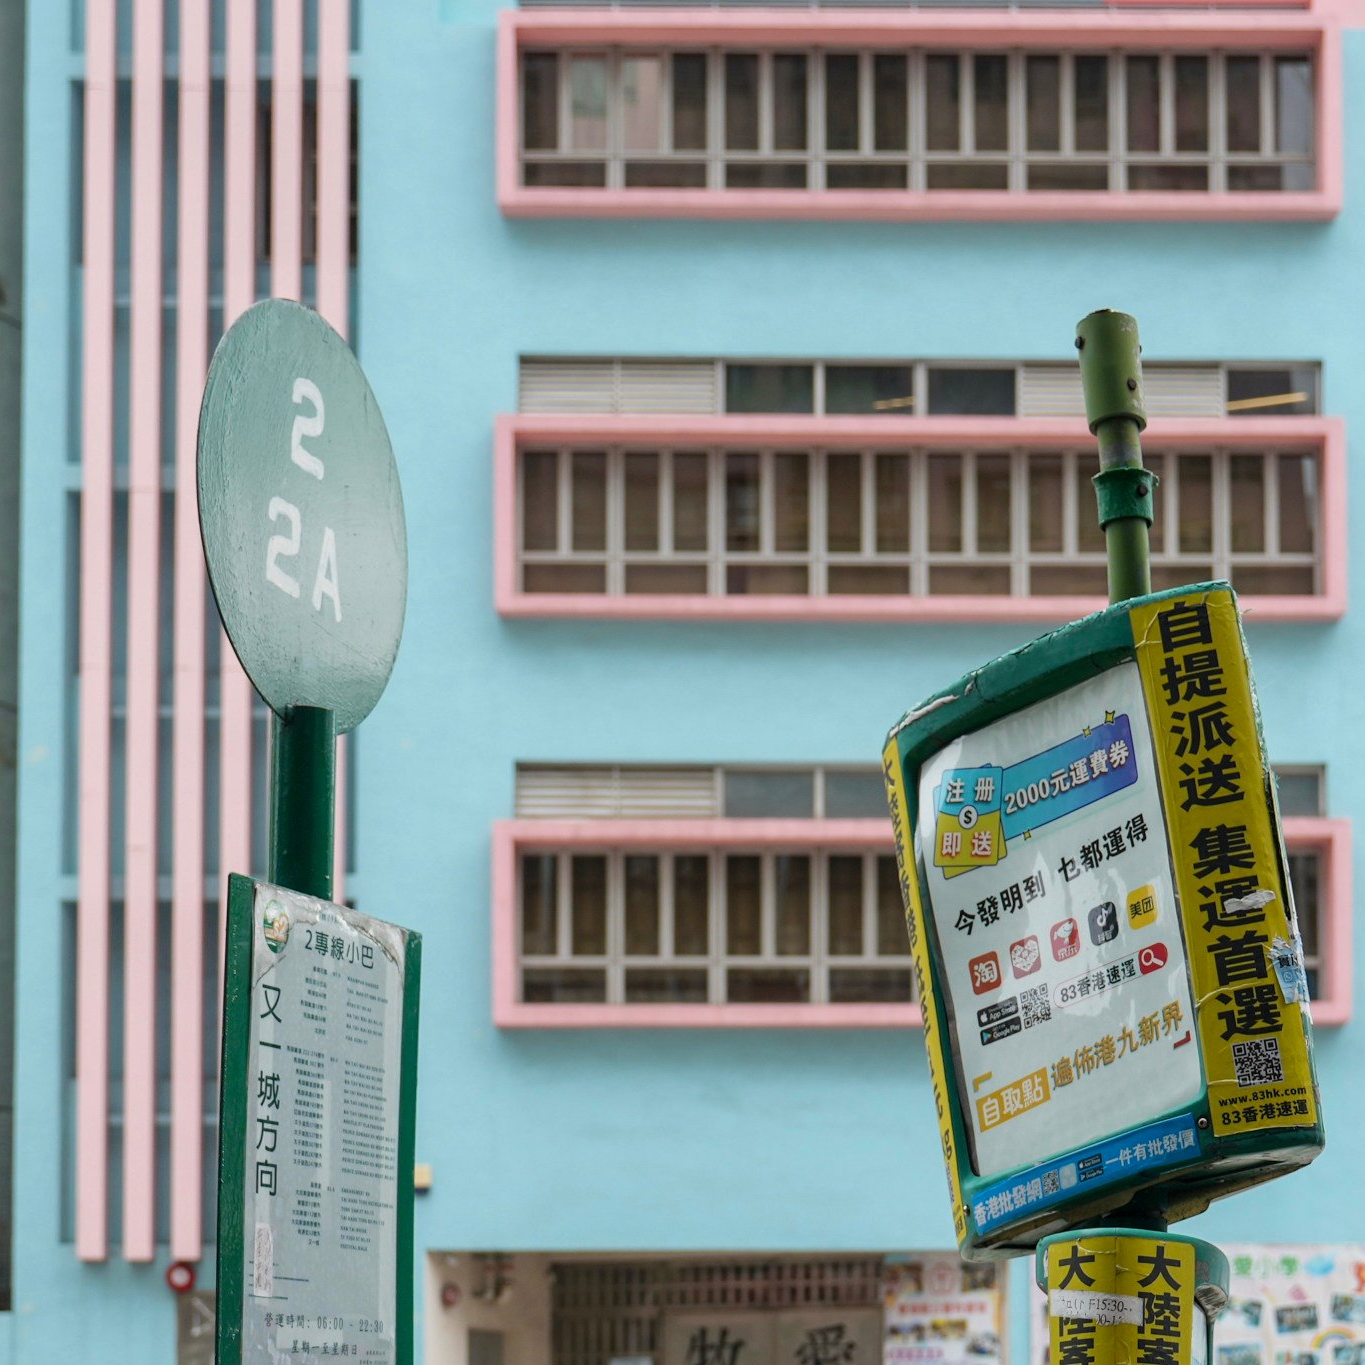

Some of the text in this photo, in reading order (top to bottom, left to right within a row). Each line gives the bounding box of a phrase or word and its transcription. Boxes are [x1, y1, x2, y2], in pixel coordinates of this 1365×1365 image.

[291, 377, 325, 481] 2
[266, 496, 342, 622] 2A
[1004, 740, 1130, 815] 2000元運費券
[1158, 601, 1284, 1042] 自提派送 集運首選
[942, 832, 993, 857] 即送
[954, 813, 1149, 936] 今發明到 乜都運得
[305, 929, 374, 970] 2專線小巴
[974, 960, 998, 988] 淘
[1060, 958, 1137, 1003] 83香港速運
[982, 1000, 1184, 1127] 自取點 遍佈港九新界
[255, 984, 282, 1196] 又一城方向
[1219, 1087, 1307, 1107] www.83hk.com
[1221, 1099, 1309, 1126] 83香港速運
[1105, 1129, 1196, 1167] 一件有批發價
[974, 1177, 1044, 1227] 香港批發網
[317, 1316, 344, 1331] 06:00
[359, 1319, 384, 1333] 22:30
[291, 1340, 358, 1356] 星期一至星期日
